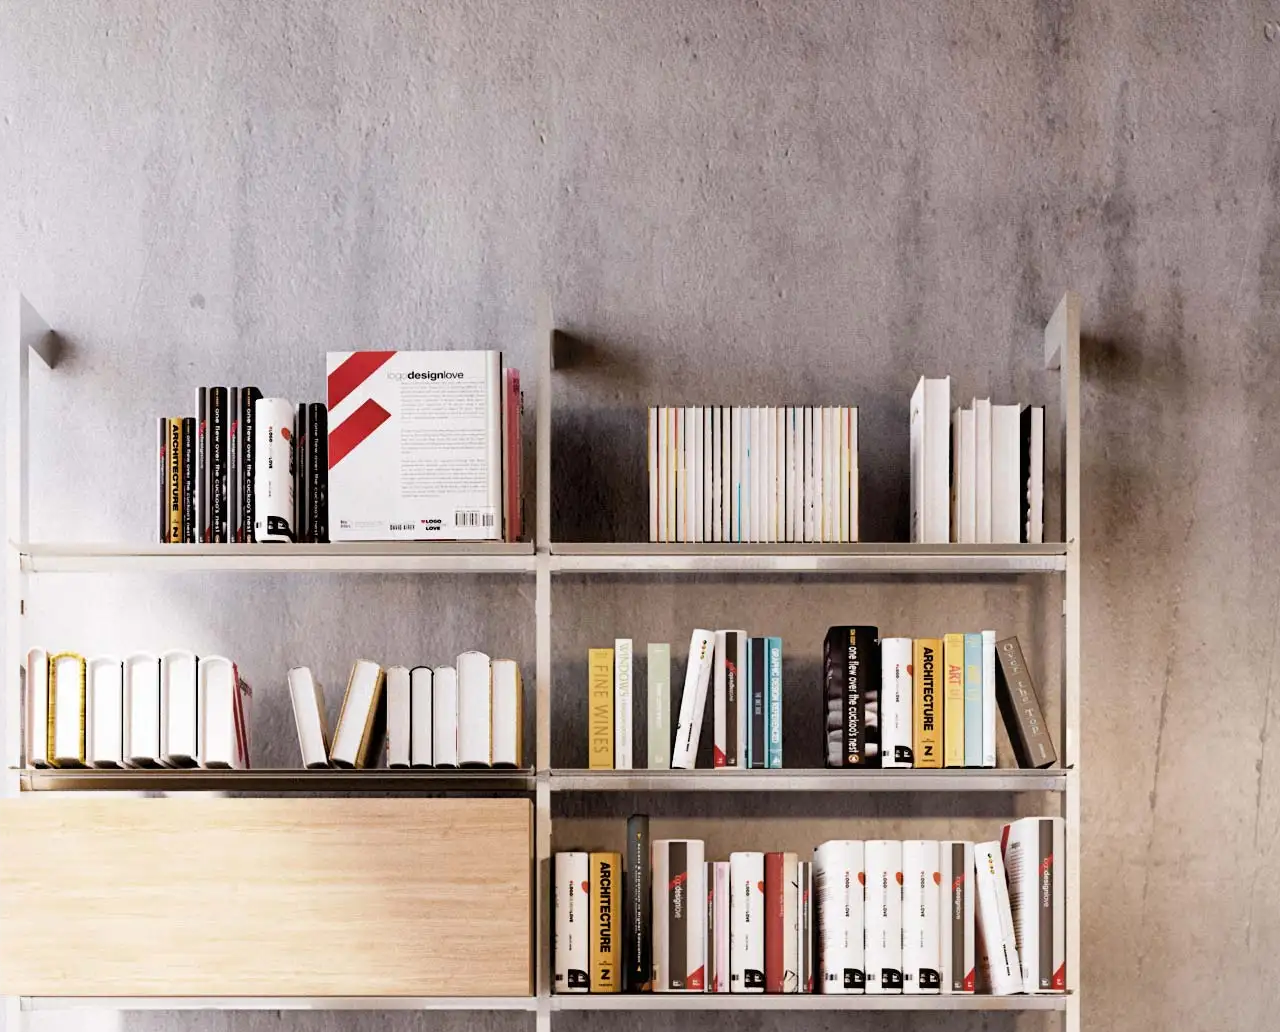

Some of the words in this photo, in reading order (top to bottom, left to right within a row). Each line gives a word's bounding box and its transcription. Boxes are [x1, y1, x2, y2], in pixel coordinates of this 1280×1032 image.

[772, 648, 780, 677] GRAPHIC
[848, 646, 858, 660] one
[619, 643, 629, 697] WINDOWS
[848, 661, 858, 676] flew
[948, 665, 961, 685] ART
[594, 665, 609, 699] FINE
[848, 677, 858, 692] over
[923, 647, 934, 731] ARCHITECTURE
[848, 694, 858, 706] the
[594, 705, 609, 754] WINES
[848, 738, 858, 753] nest
[600, 861, 611, 953] ARCHITECTURE
